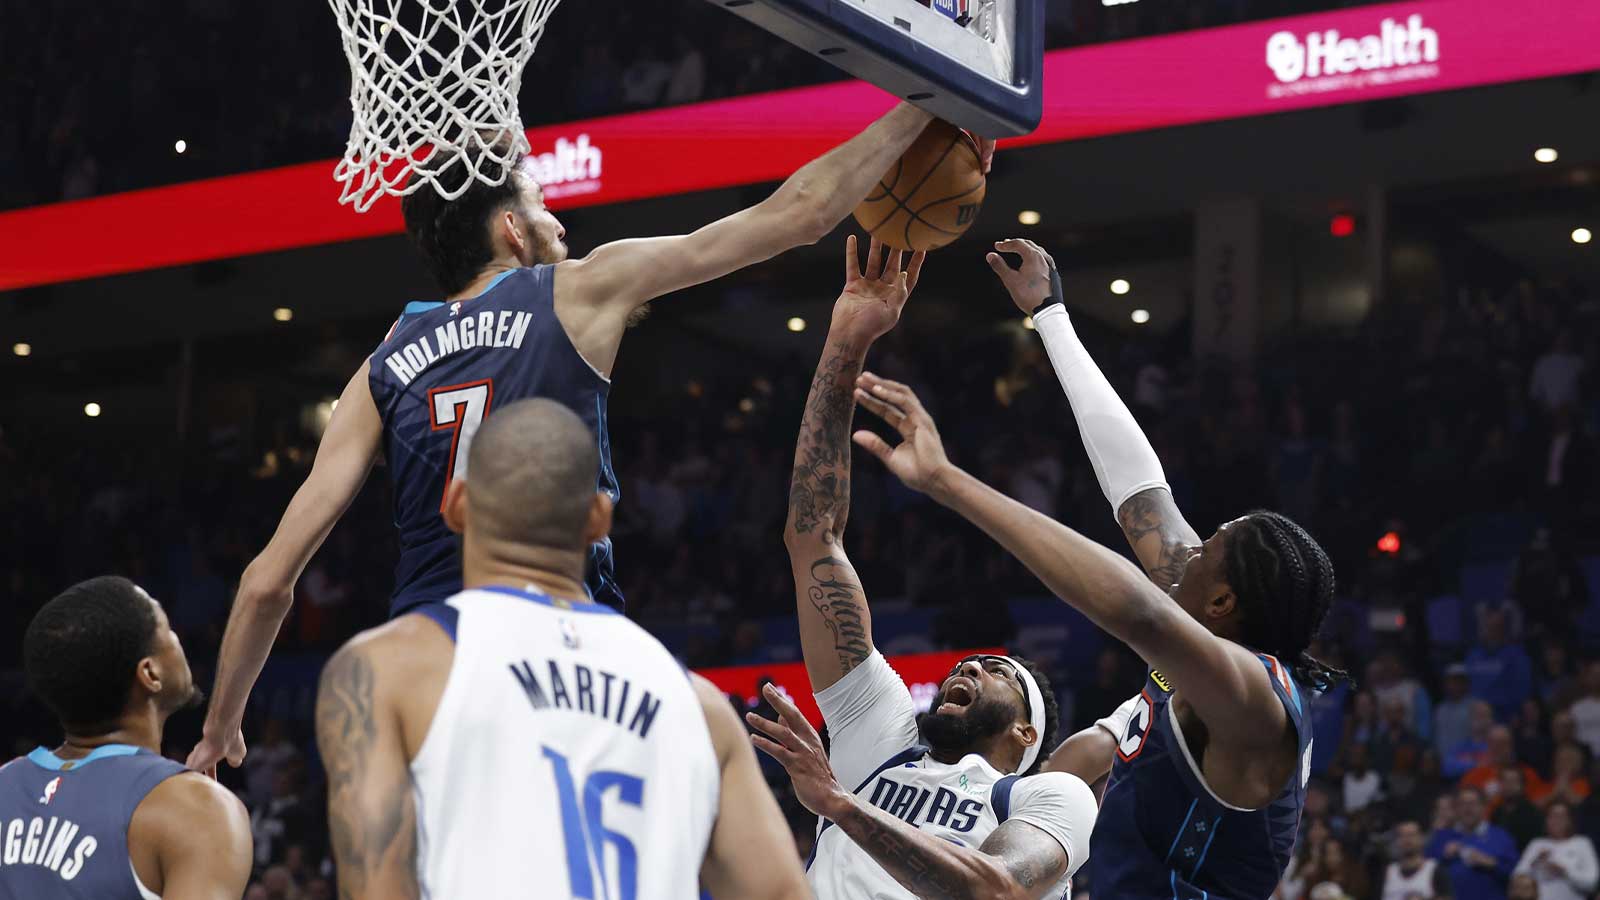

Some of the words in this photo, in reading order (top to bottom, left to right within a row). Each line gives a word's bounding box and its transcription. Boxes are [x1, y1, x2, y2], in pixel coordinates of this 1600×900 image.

[1306, 14, 1439, 77] Health
[521, 134, 602, 186] ealth
[384, 310, 533, 386] HOLMGREN
[427, 378, 494, 513] 7
[508, 659, 661, 739] MARTIN
[541, 744, 645, 900] 16
[869, 776, 984, 833] DALAS
[0, 816, 98, 880] GGINS
